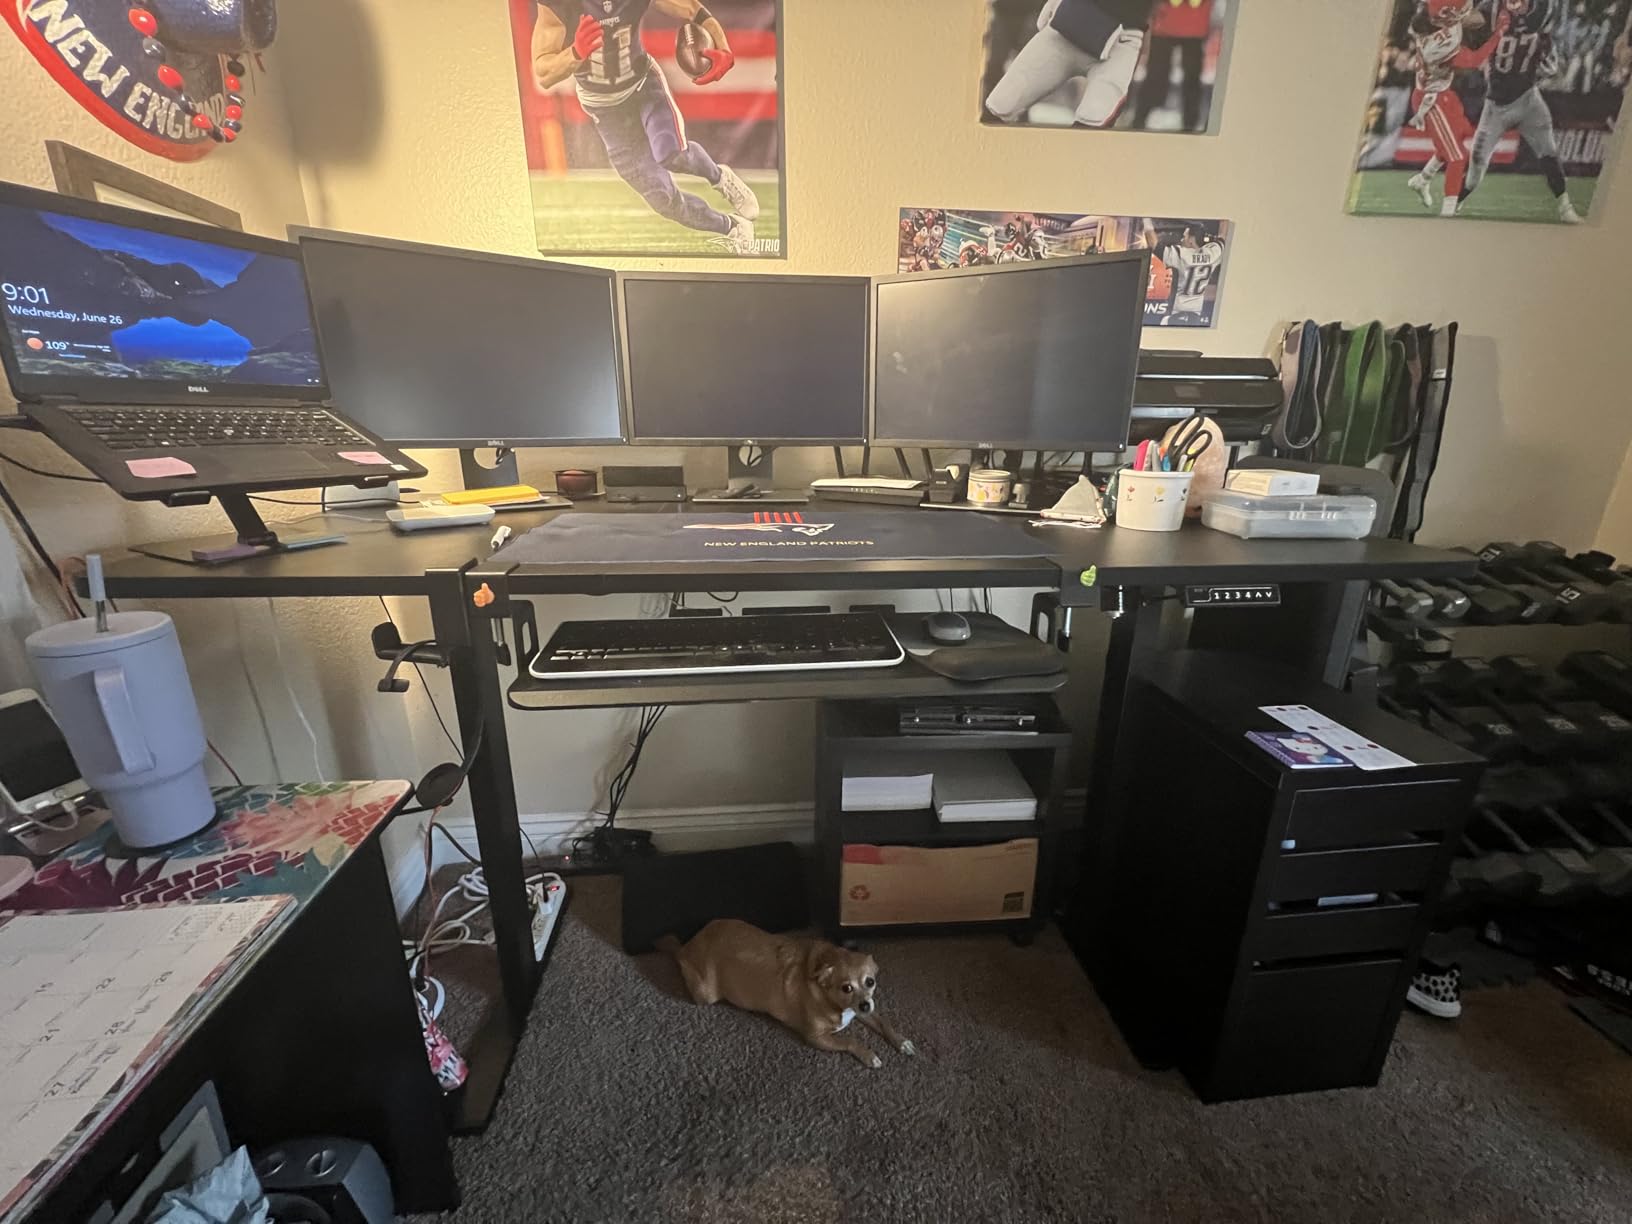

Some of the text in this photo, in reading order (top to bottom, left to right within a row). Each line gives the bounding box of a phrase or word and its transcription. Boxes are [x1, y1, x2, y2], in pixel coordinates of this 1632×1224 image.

[28, 0, 131, 98] NEW
[587, 24, 635, 85] 11
[1495, 32, 1538, 73] 87
[1191, 254, 1212, 264] BRADY
[1180, 265, 1212, 295] 12
[1, 282, 51, 305] 9:01
[8, 304, 123, 325] Wednesday, June 26
[1224, 591, 1231, 600] 2
[1235, 591, 1241, 600] 3
[1244, 590, 1252, 599] 4
